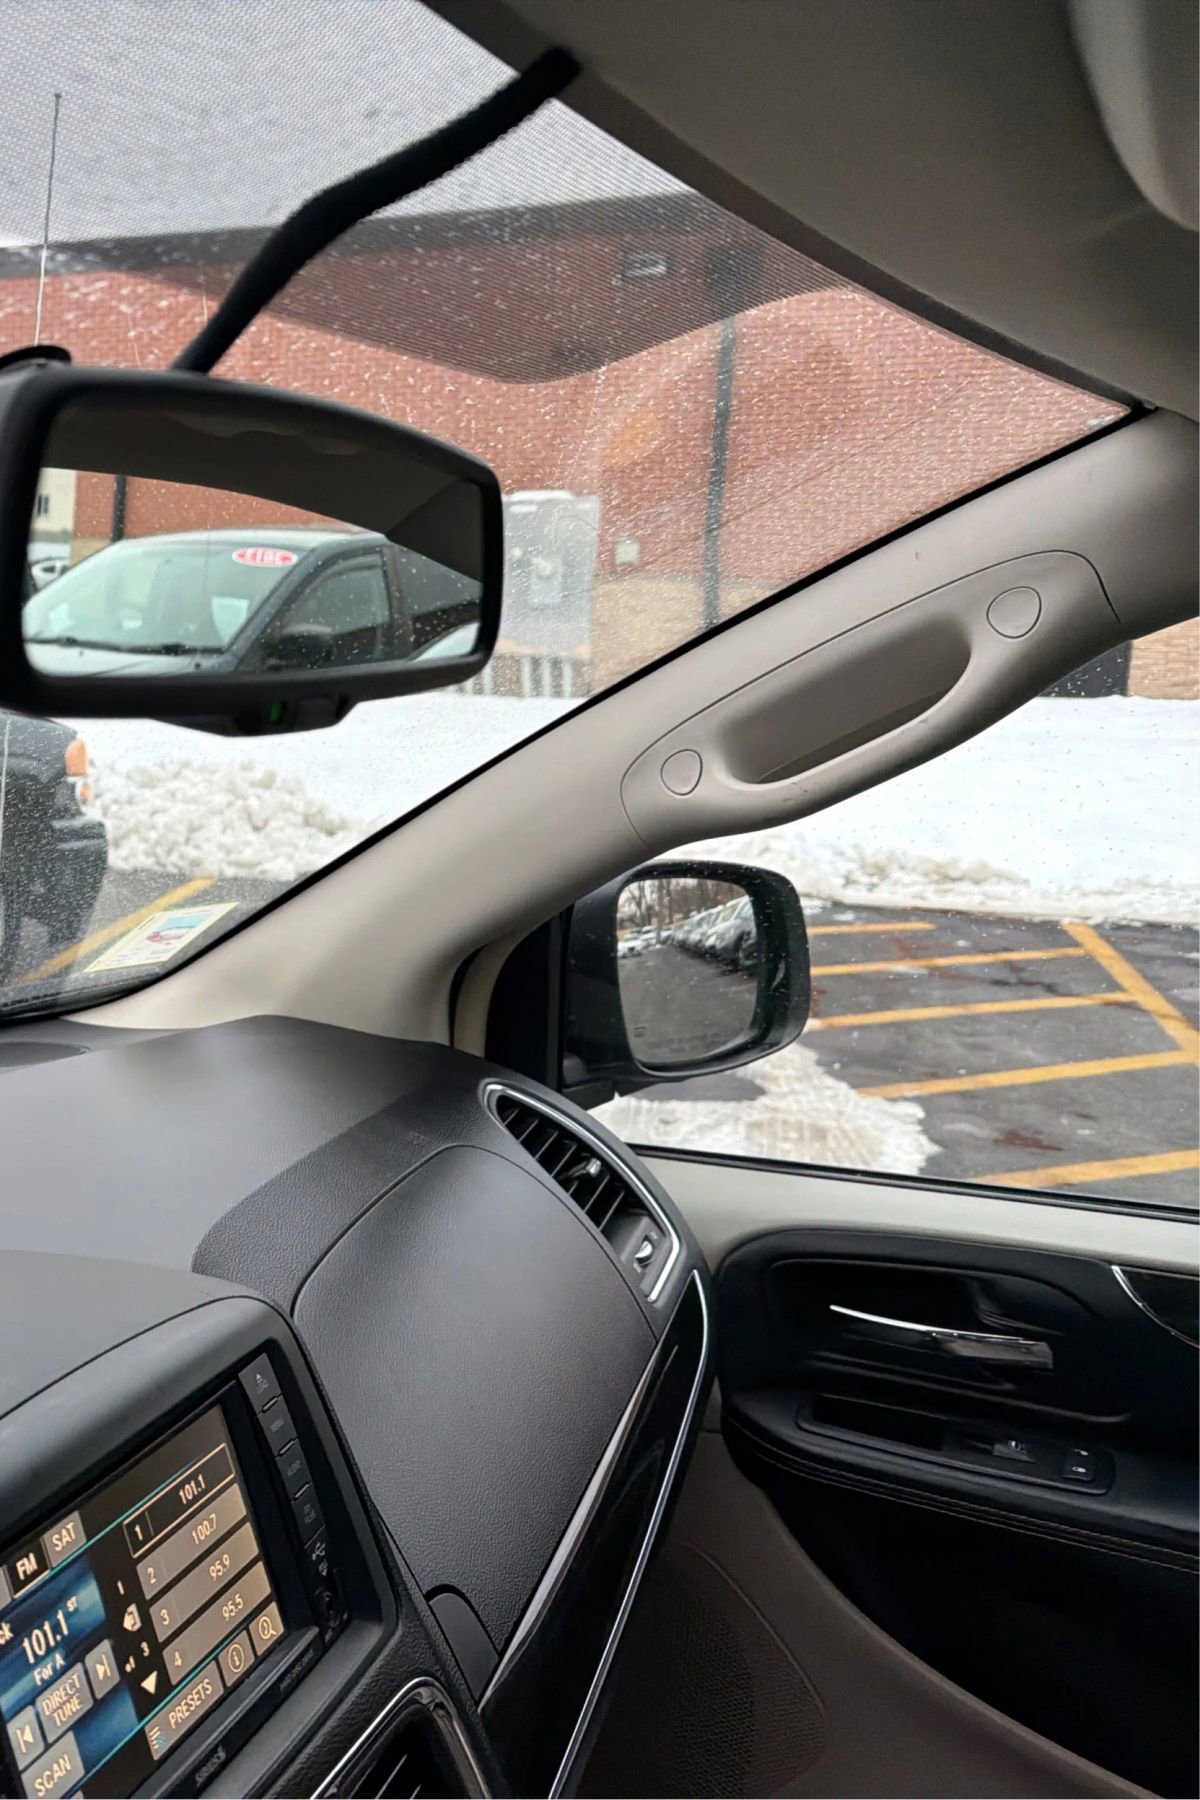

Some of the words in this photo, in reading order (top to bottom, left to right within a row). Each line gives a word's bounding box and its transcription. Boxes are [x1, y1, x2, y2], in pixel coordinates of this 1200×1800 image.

[133, 1524, 143, 1541] 1
[179, 1473, 206, 1504] 101.1
[52, 1522, 76, 1551] SAT
[147, 1567, 157, 1584] 2
[191, 1513, 217, 1544] 100.7
[15, 1552, 38, 1581] FM
[160, 1609, 170, 1625] 3
[209, 1554, 230, 1581] 95.9
[22, 1609, 70, 1664] 101.1
[140, 1641, 150, 1657] 3
[173, 1651, 183, 1667] 4
[222, 1593, 244, 1621] 95.5
[33, 1663, 54, 1686] For
[55, 1653, 66, 1670] A
[41, 1672, 81, 1716] DIRECT
[51, 1693, 83, 1727] TUNE
[168, 1678, 212, 1729] PRESETS
[34, 1753, 73, 1798] SCAN
